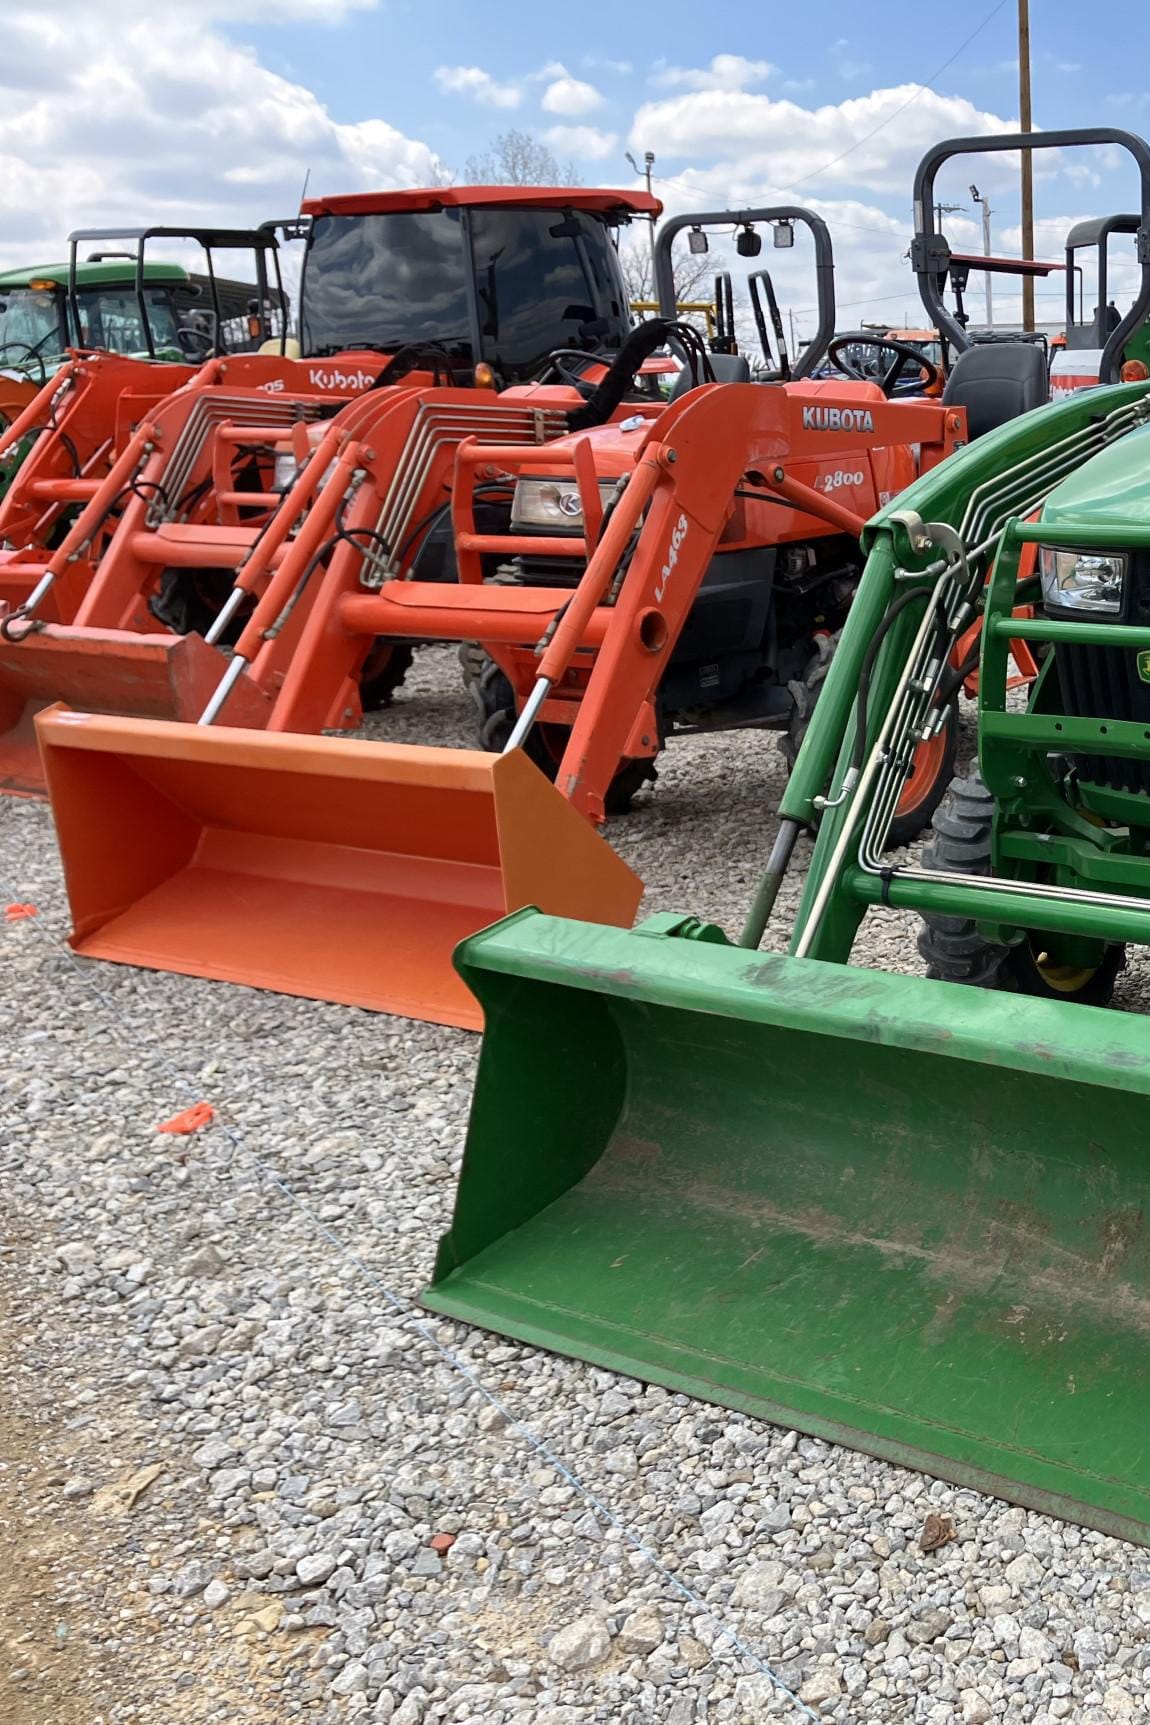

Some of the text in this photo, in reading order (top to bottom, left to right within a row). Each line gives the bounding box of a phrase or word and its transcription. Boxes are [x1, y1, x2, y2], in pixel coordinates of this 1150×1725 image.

[309, 369, 375, 389] Kubota
[802, 406, 874, 433] KUBOTA
[654, 513, 688, 604] LA463
